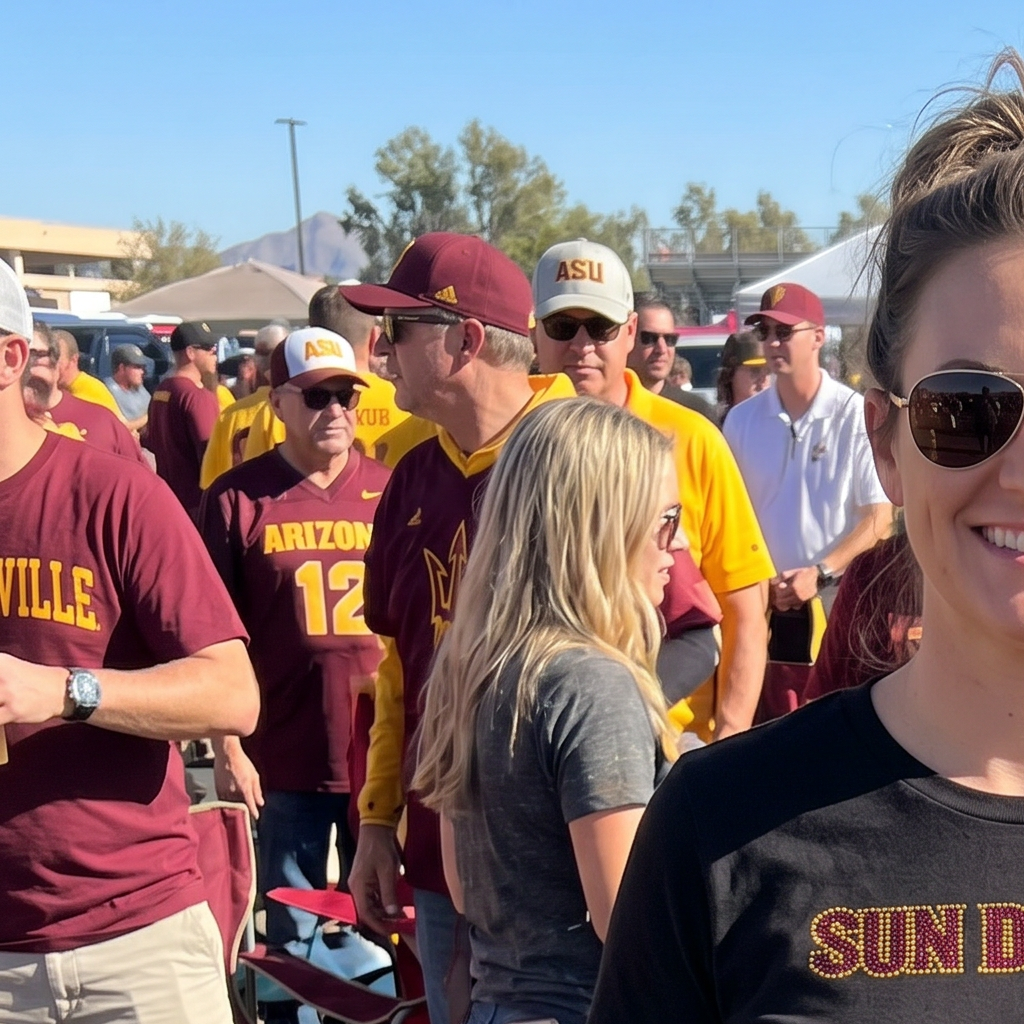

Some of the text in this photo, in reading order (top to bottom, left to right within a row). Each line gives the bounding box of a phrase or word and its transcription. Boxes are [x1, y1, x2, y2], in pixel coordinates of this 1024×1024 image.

[555, 259, 604, 284] ASU
[305, 339, 343, 361] ASU
[263, 520, 374, 555] ARIZON
[0, 557, 96, 631] VILLE
[295, 560, 374, 636] 12
[808, 904, 967, 979] SUN
